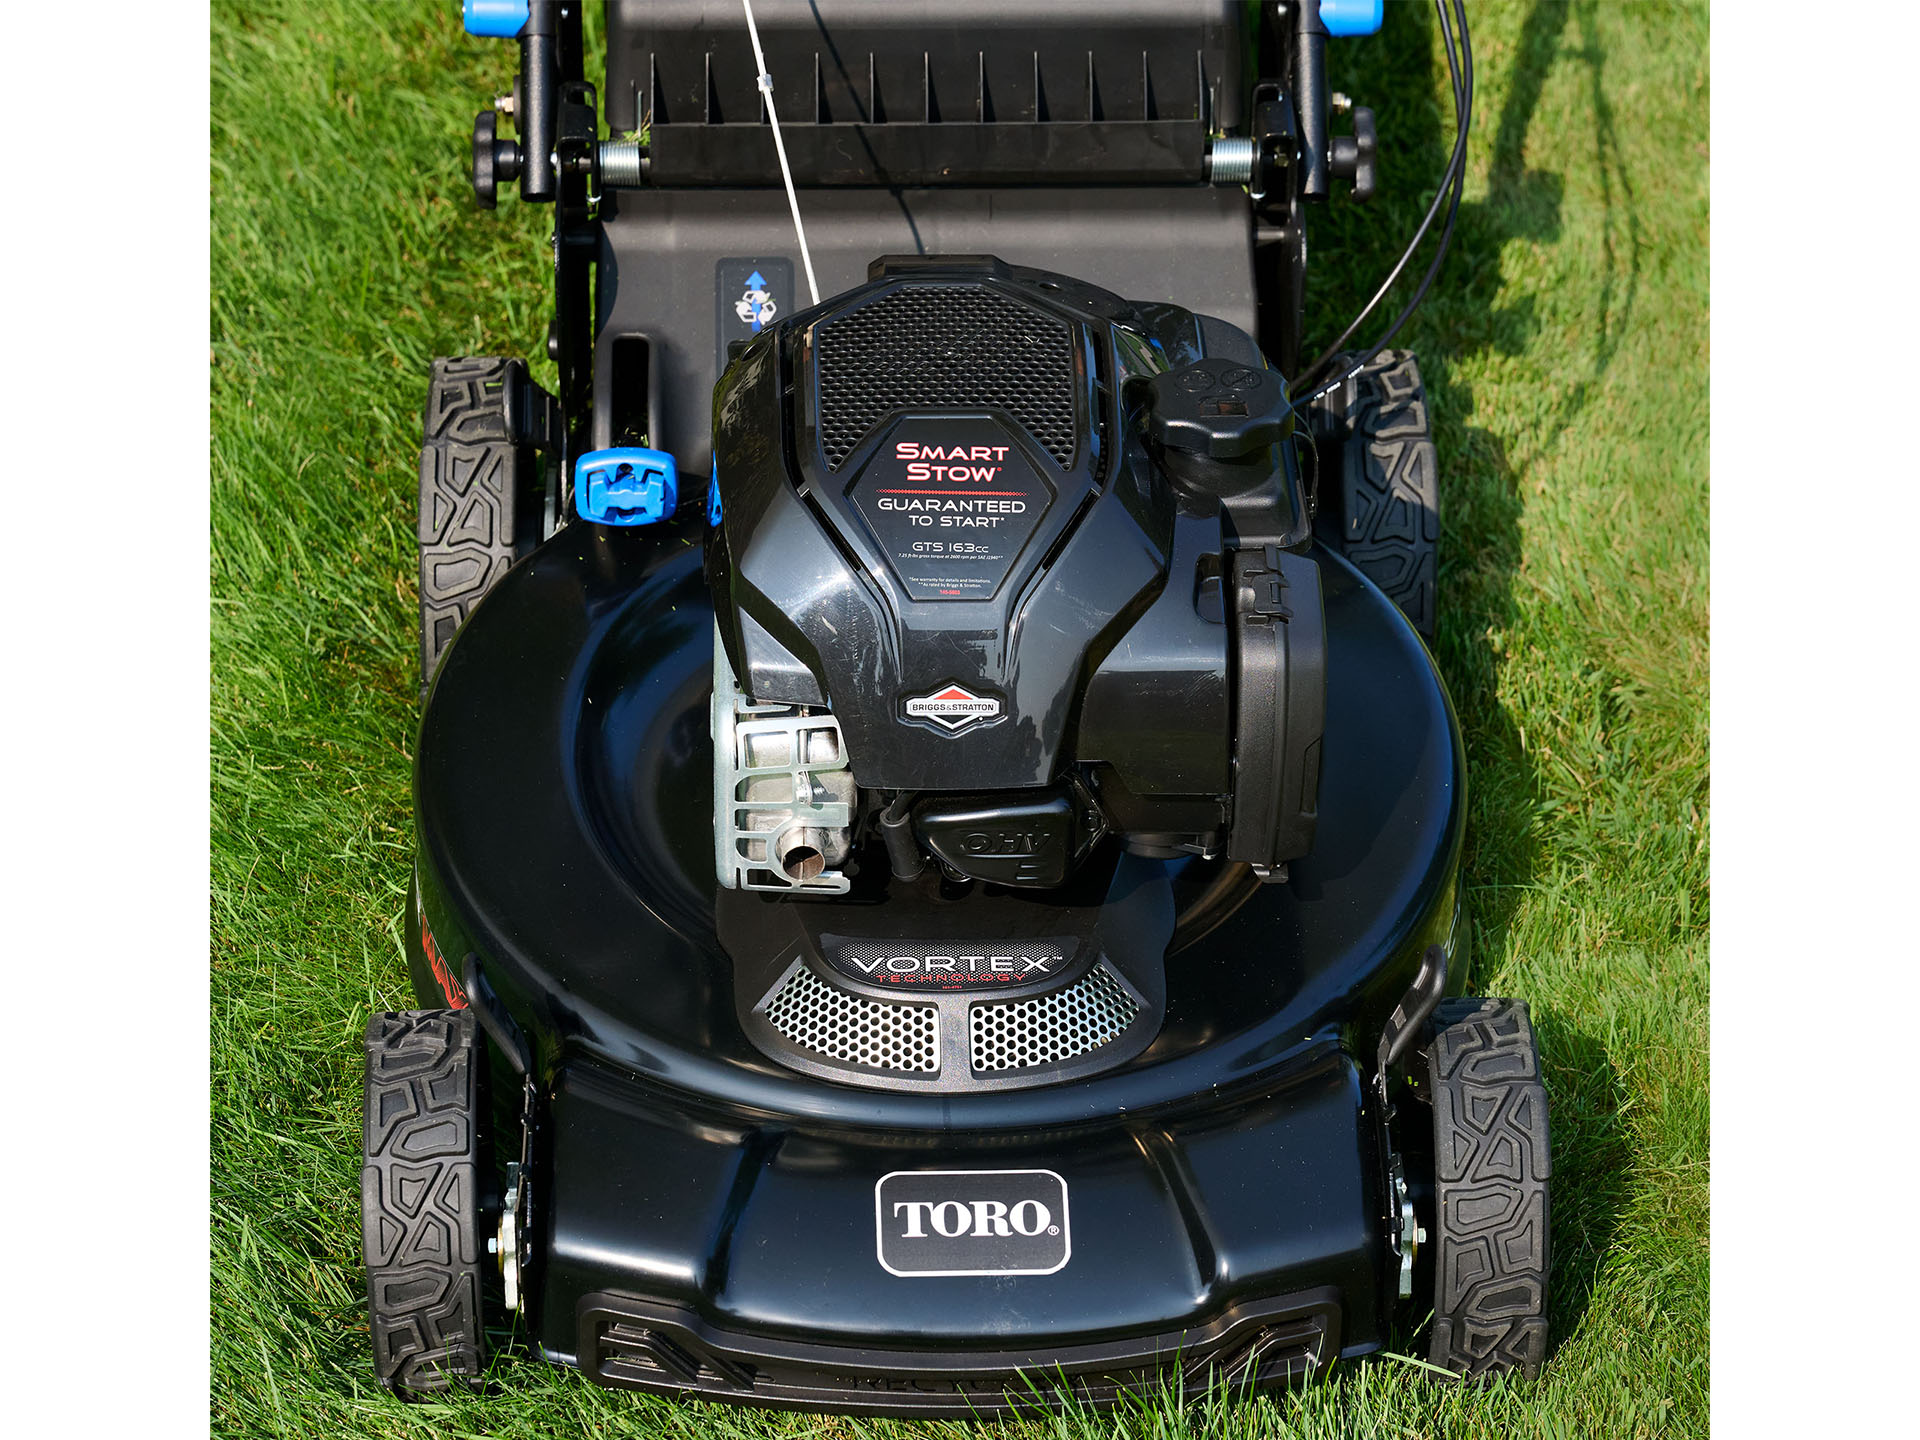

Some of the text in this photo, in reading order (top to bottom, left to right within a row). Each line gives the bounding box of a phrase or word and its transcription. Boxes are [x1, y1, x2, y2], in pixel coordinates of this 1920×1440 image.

[896, 442, 1010, 462] SMART
[877, 498, 1026, 514] GUARANTEED
[908, 514, 934, 528] TO
[912, 541, 989, 554] GTS 163cc
[876, 974, 1027, 983] TECHNOLOGY
